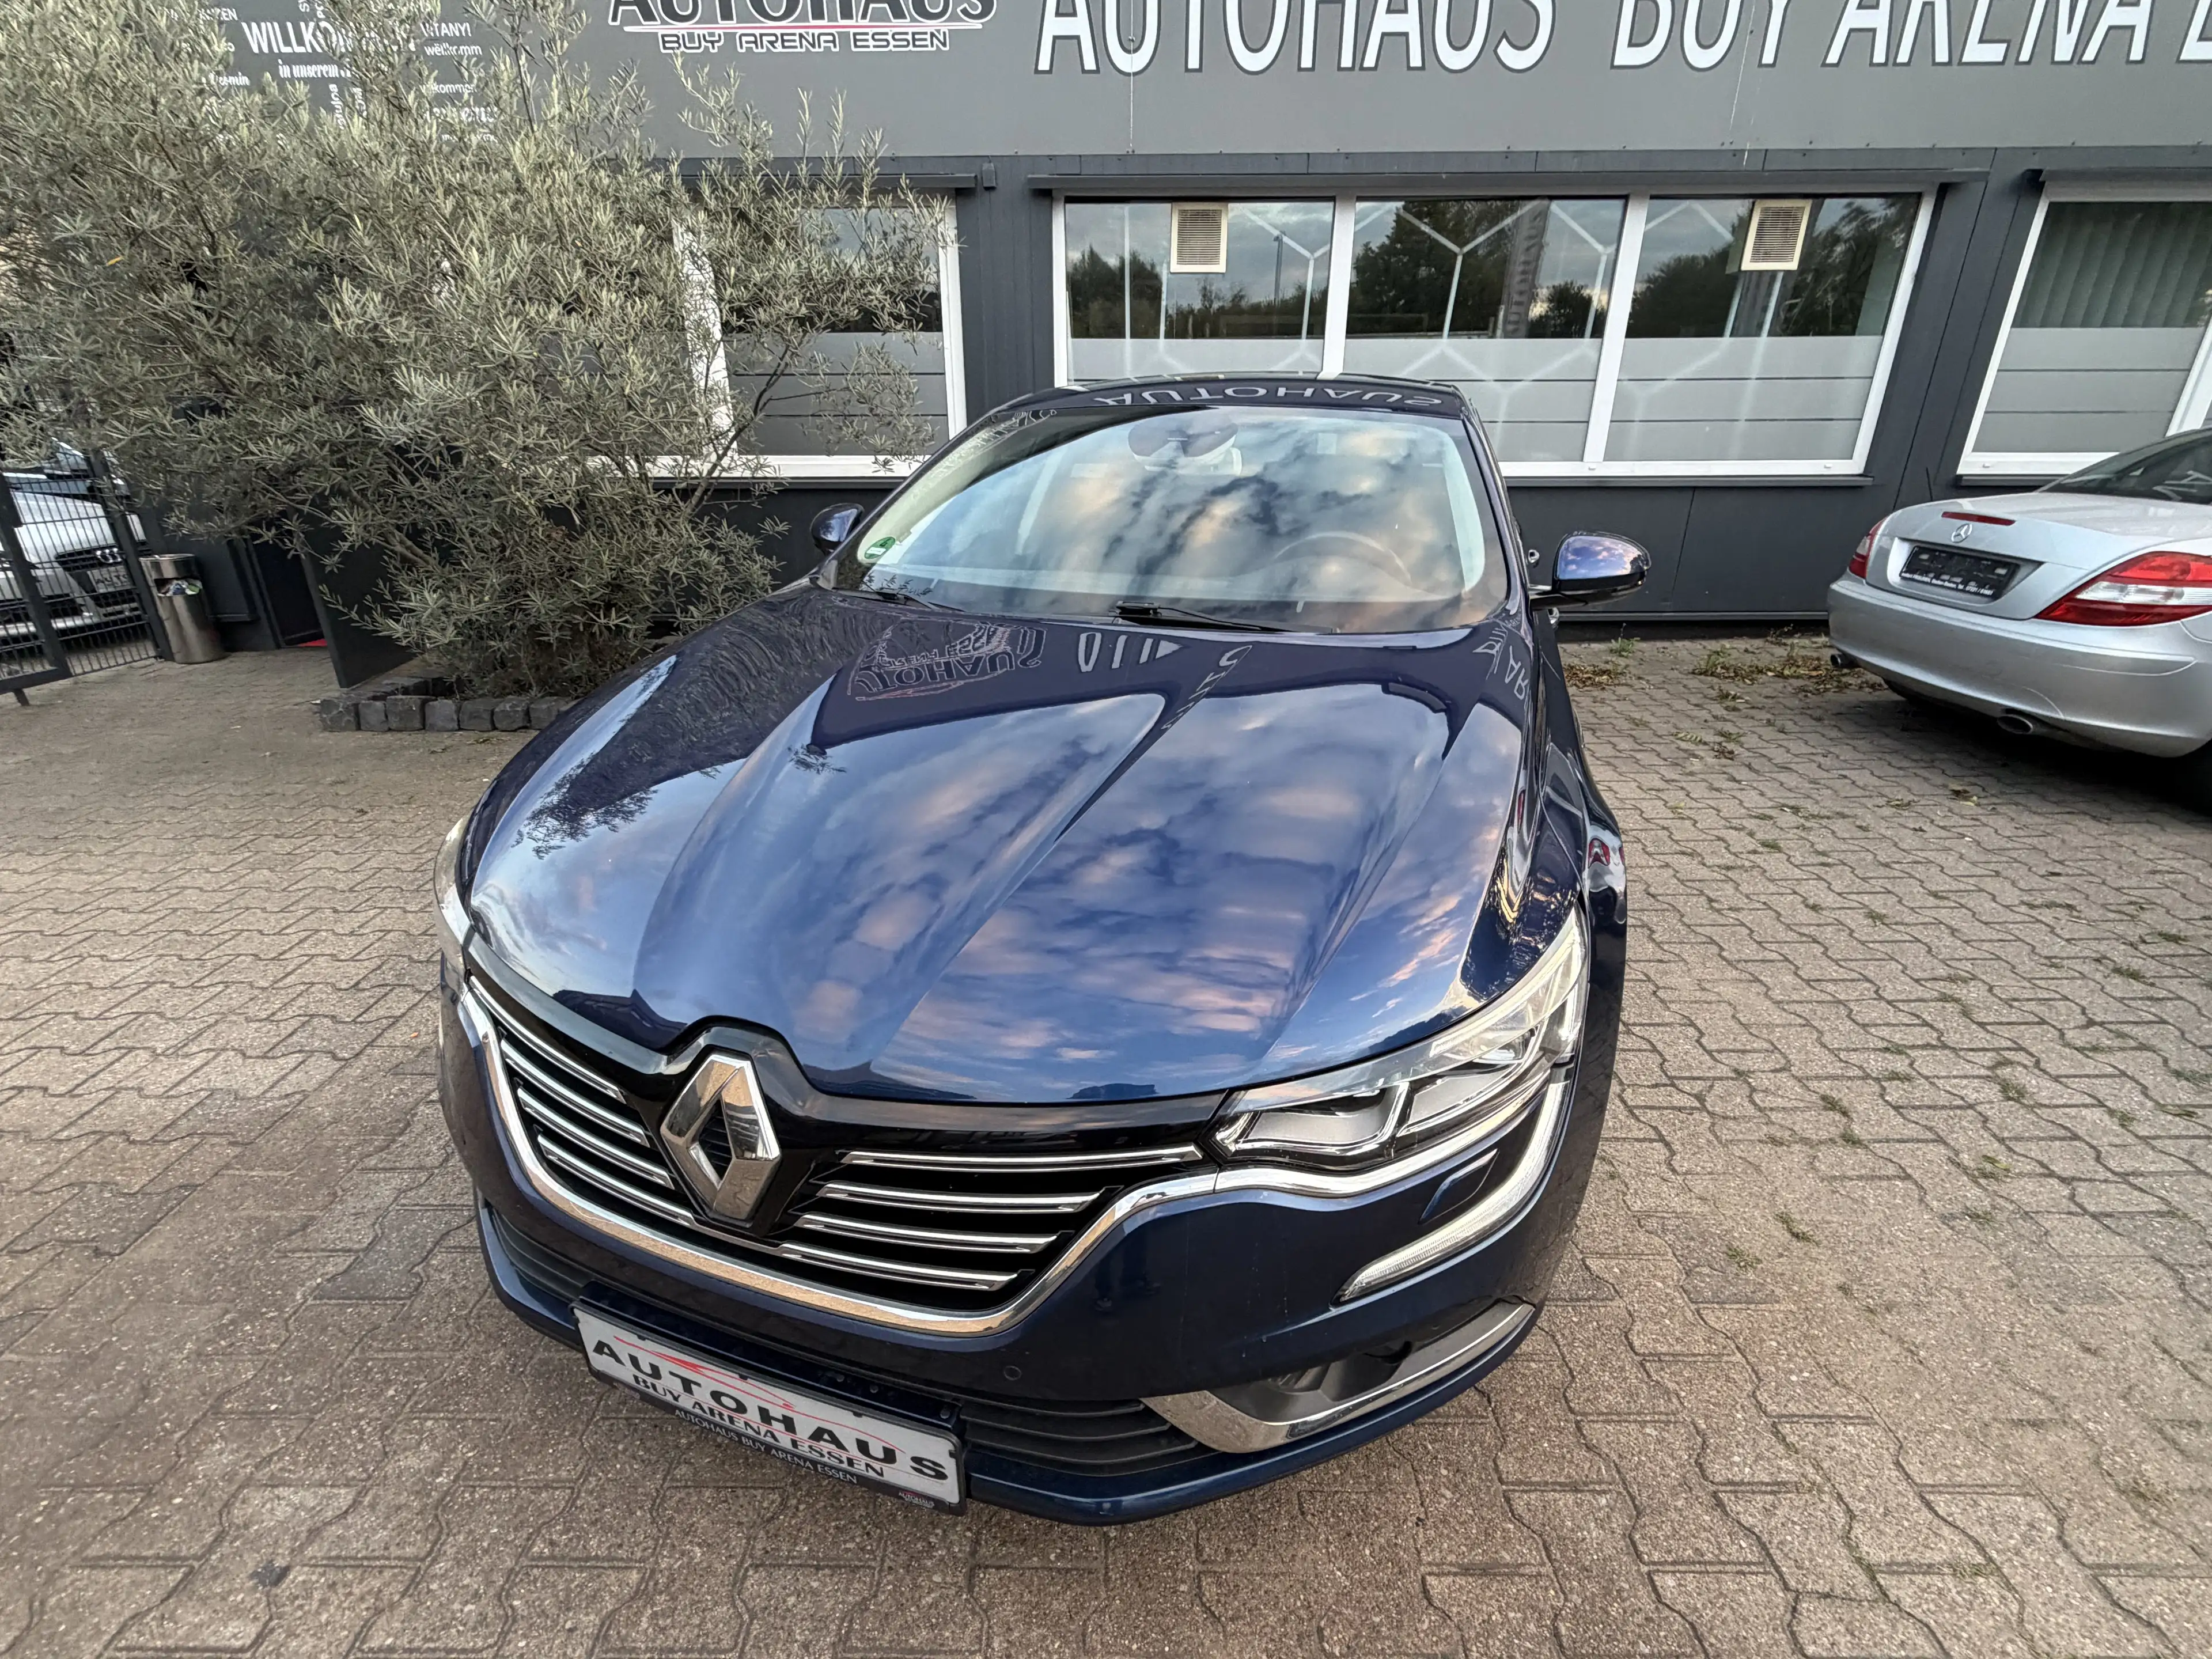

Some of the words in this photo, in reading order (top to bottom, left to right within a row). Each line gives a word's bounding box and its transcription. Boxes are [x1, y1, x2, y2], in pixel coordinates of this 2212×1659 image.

[278, 59, 291, 78] in
[659, 31, 725, 53] BUY
[737, 30, 840, 52] ARENA
[851, 29, 950, 51] ESSEN
[593, 1340, 948, 1481] AUTOHAUS
[632, 1374, 681, 1403] BUY
[692, 1401, 782, 1444] ARENA
[790, 1437, 884, 1478] ESSEN
[675, 1410, 739, 1441] AUTOHAUS
[742, 1437, 767, 1452] BUY
[771, 1449, 813, 1469] ARENA
[818, 1464, 857, 1484] ESSEN
